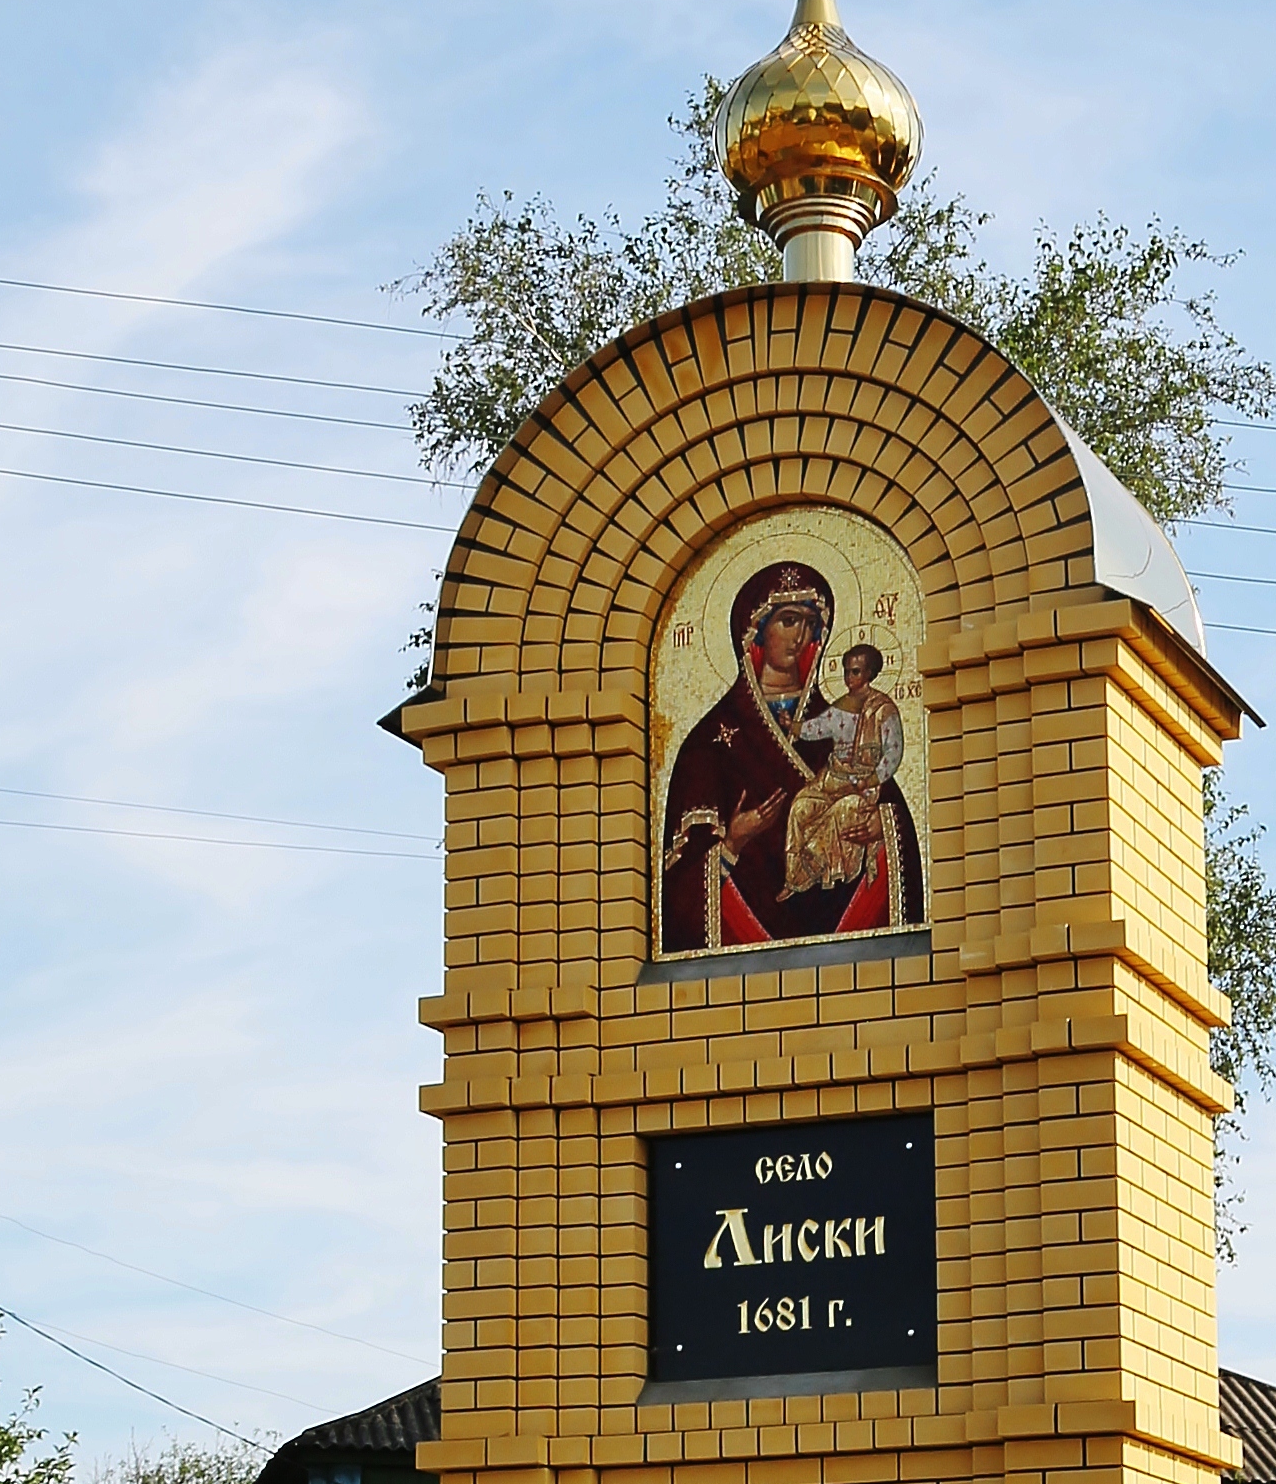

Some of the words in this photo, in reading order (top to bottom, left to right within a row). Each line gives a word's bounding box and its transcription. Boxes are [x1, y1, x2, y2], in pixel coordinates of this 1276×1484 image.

[703, 1207, 886, 1270] Лиски
[736, 1295, 813, 1335] 1681
[828, 1299, 853, 1329] г.
